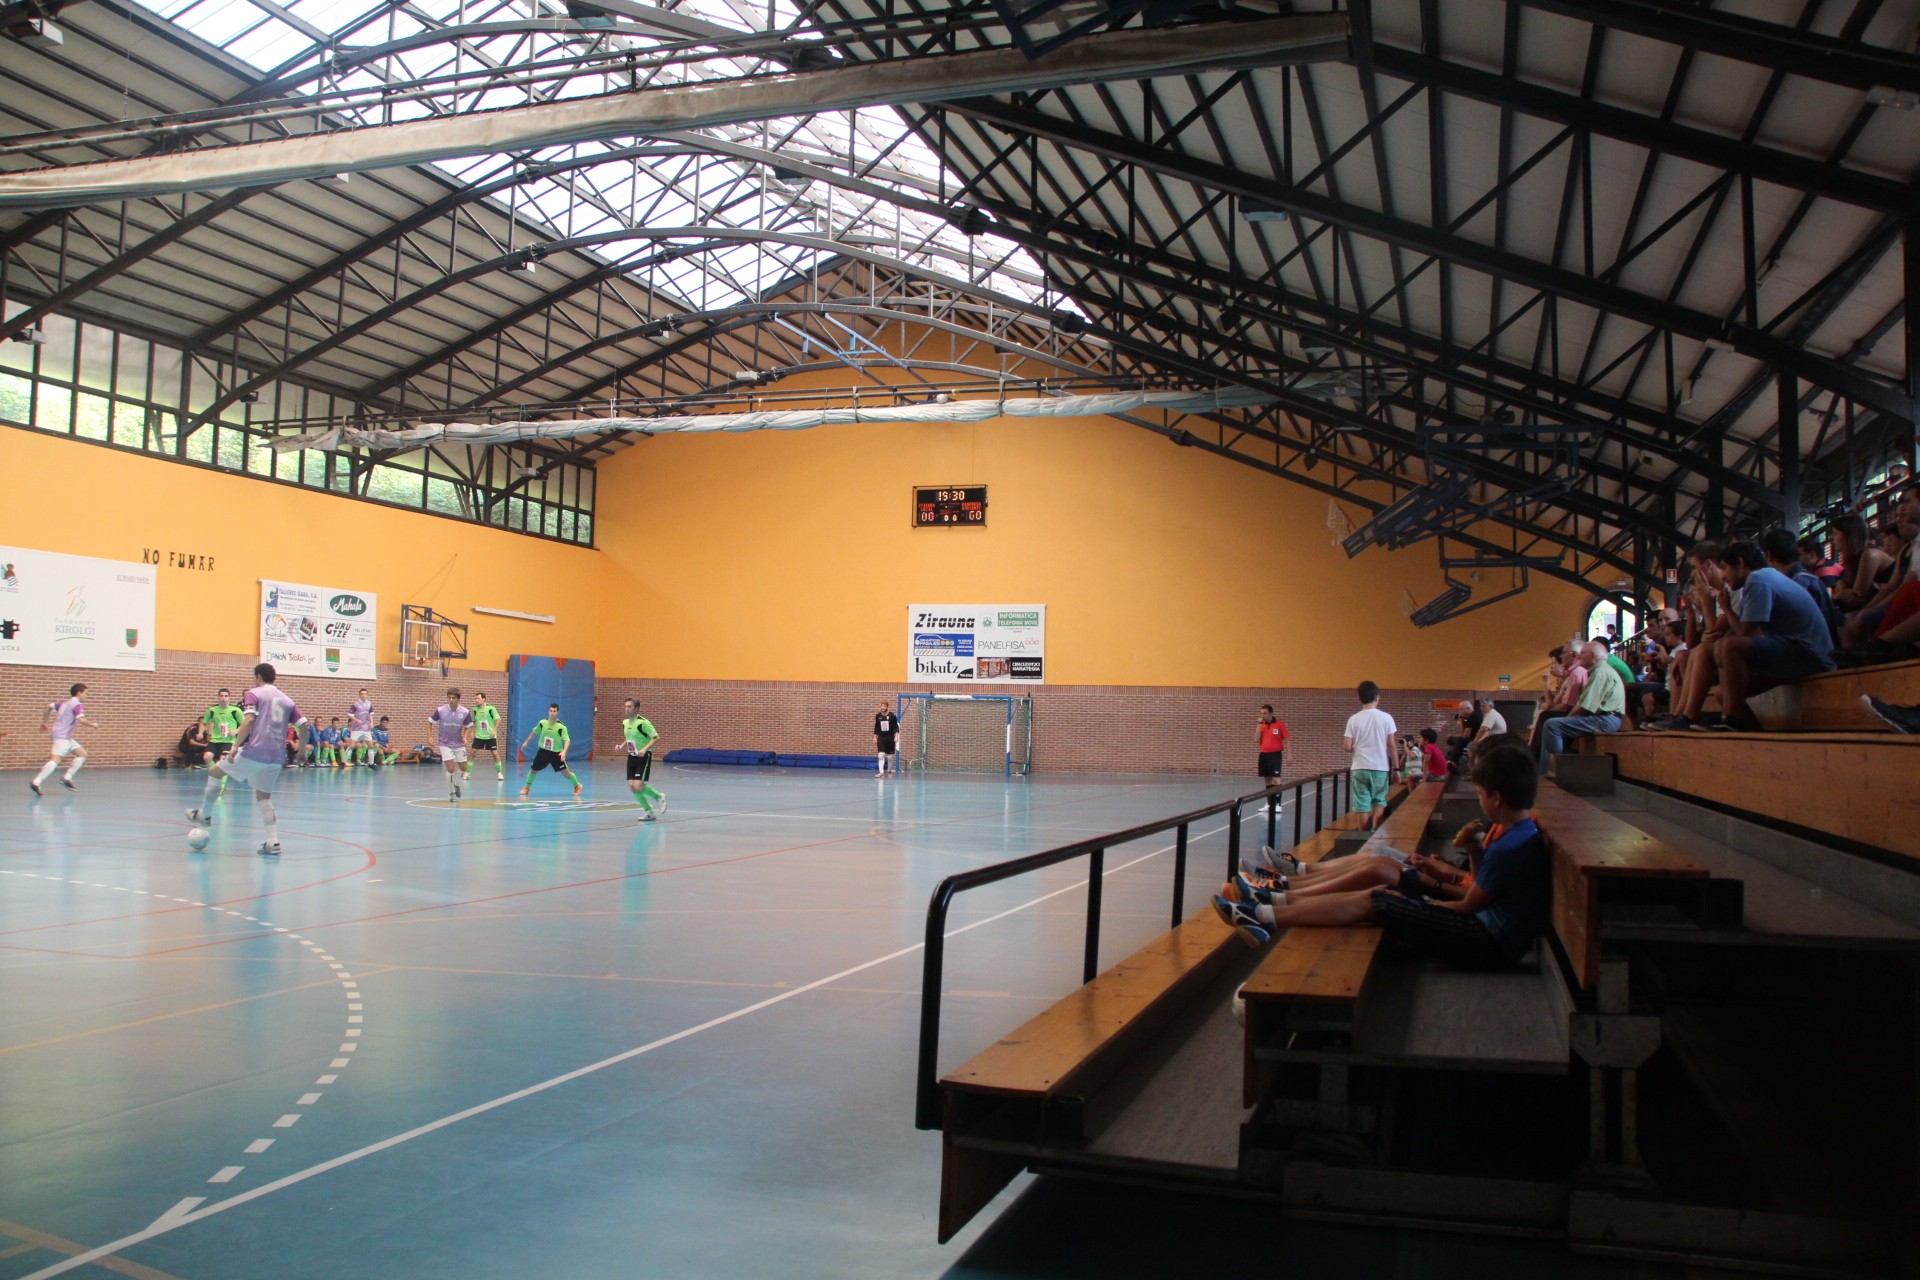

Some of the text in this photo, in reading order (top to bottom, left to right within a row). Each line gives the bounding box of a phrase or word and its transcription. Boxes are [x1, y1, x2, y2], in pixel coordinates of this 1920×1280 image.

[143, 548, 215, 571] NO FUMAR
[333, 597, 363, 612] Mahala
[915, 613, 975, 628] Zirauna
[55, 625, 95, 635] KIROLGI
[332, 631, 348, 639] TZE
[977, 640, 1025, 650] PANELFISA
[915, 657, 959, 674] bikutz
[271, 696, 284, 722] 6
